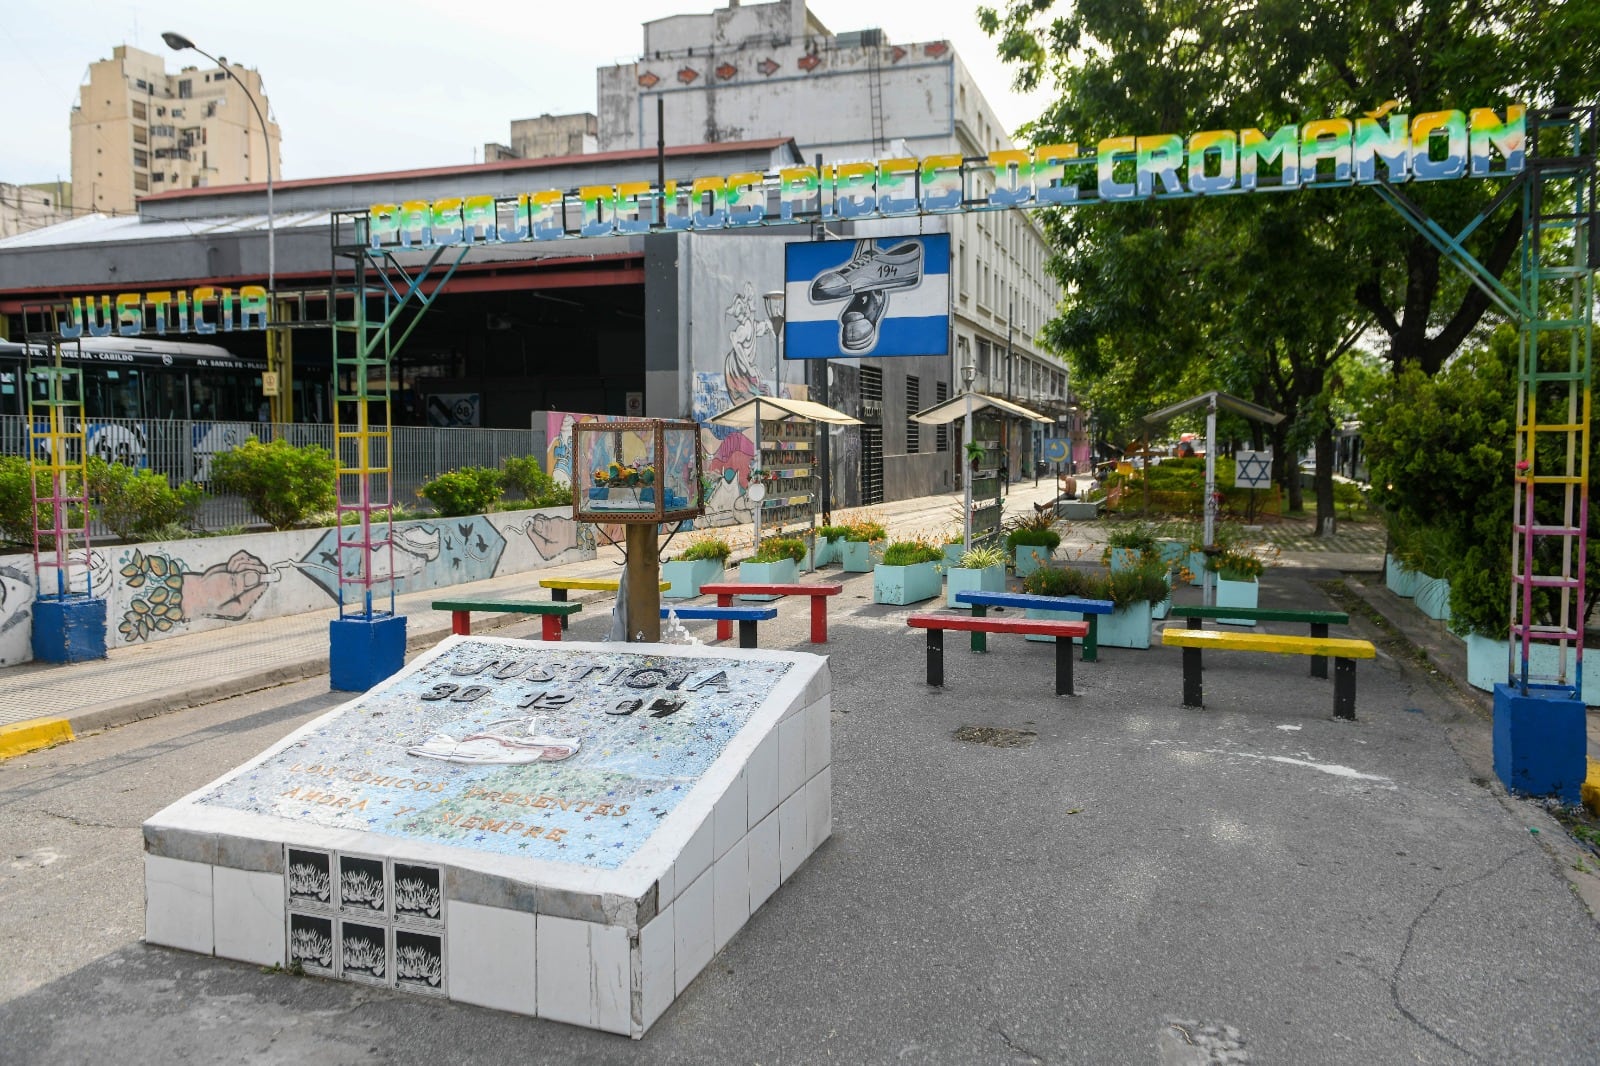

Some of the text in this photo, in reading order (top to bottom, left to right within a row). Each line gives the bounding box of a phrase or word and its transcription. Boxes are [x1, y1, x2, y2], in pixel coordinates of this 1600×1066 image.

[369, 99, 1527, 250] PASAJE DE LOS PIBES DE CROMAÑON
[876, 264, 898, 278] 194
[59, 284, 268, 339] JUSTICIA
[99, 353, 134, 362] CABILDO
[210, 360, 233, 368] SANTA
[450, 660, 730, 694] JUSTICIA
[420, 682, 493, 703] 30
[516, 691, 576, 710] 12
[289, 763, 630, 817] LOS CHICOS PRESENTES
[280, 786, 568, 843] AHORA Y SIEMPRE
